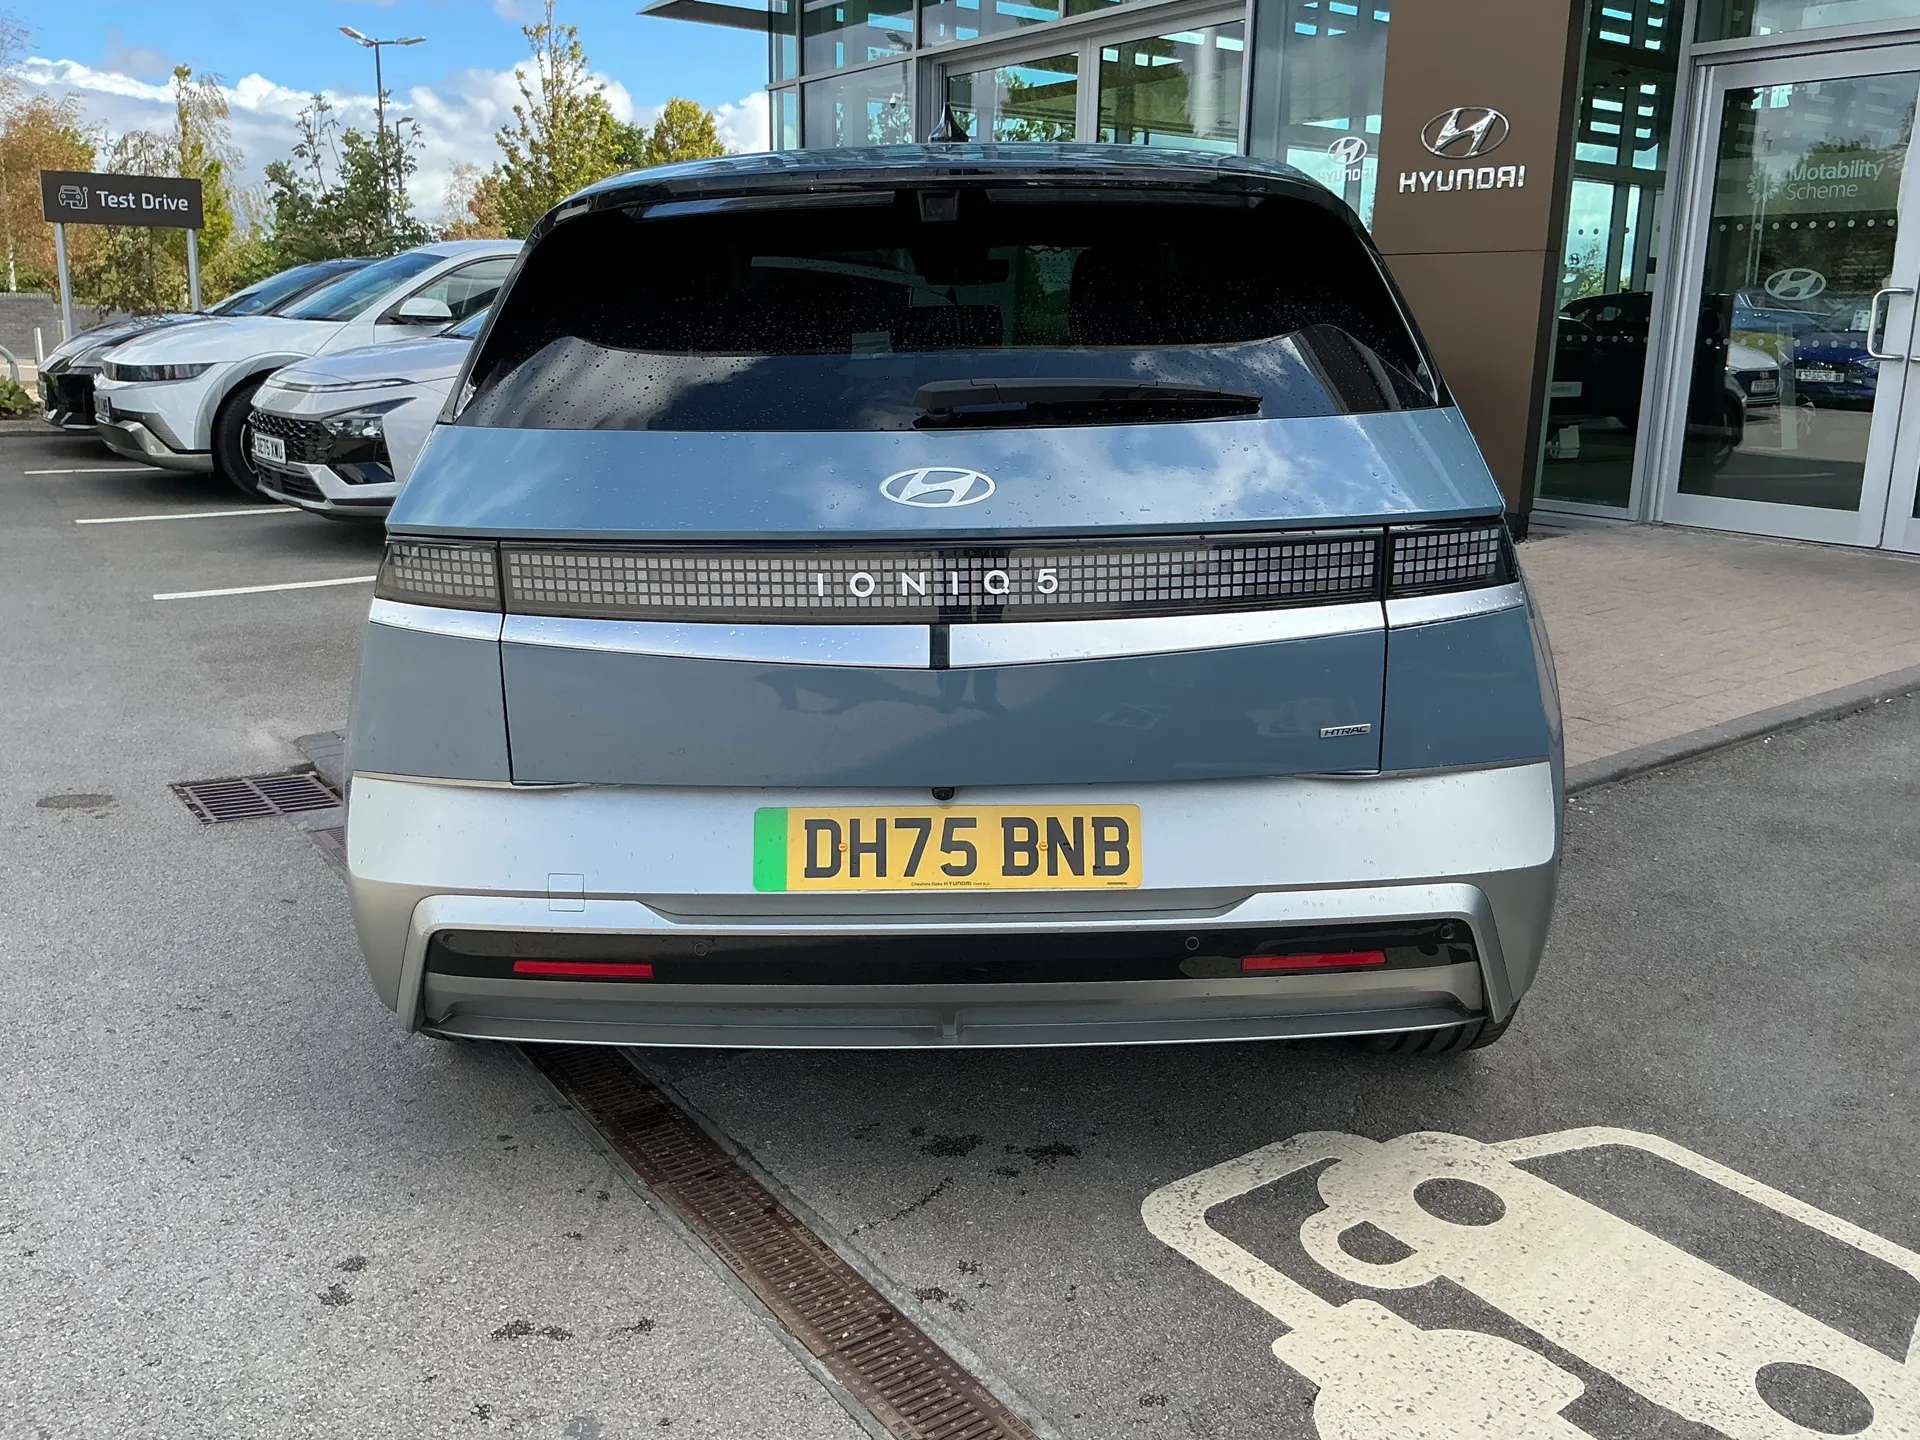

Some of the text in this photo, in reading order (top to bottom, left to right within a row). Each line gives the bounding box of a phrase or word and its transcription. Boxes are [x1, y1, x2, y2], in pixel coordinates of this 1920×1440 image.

[1399, 165, 1526, 193] HYUNDAI
[1788, 160, 1884, 181] Motability
[95, 190, 189, 211] Test Drive
[1786, 183, 1858, 200] Scheme
[817, 568, 1059, 598] IONIQ 5
[1323, 726, 1369, 736] HTRAC
[804, 816, 1130, 878] DH75 BNB
